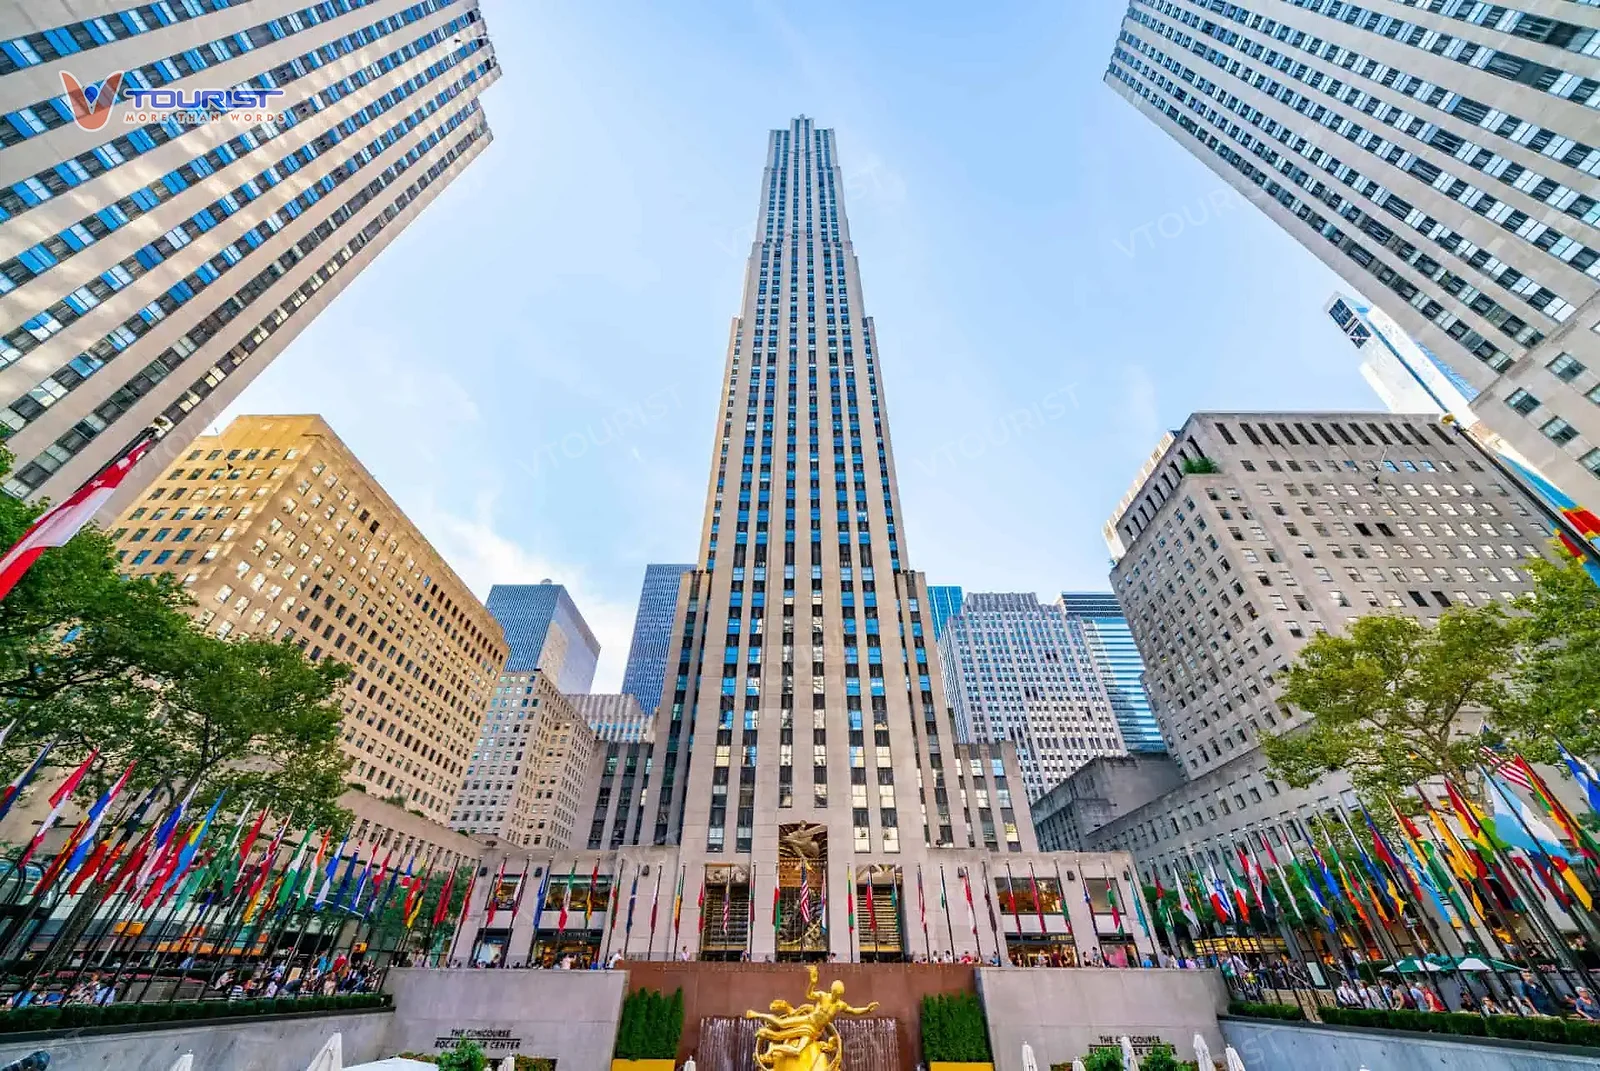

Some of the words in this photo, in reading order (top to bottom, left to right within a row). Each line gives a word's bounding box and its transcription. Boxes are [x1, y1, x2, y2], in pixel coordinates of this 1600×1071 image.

[451, 1029, 464, 1037] THE
[466, 1029, 511, 1037] CONCOURSE
[1099, 1036, 1113, 1044] THE
[1115, 1036, 1160, 1044] CCOURSE
[434, 1040, 487, 1050] ROCKER
[490, 1041, 520, 1050] CENTER
